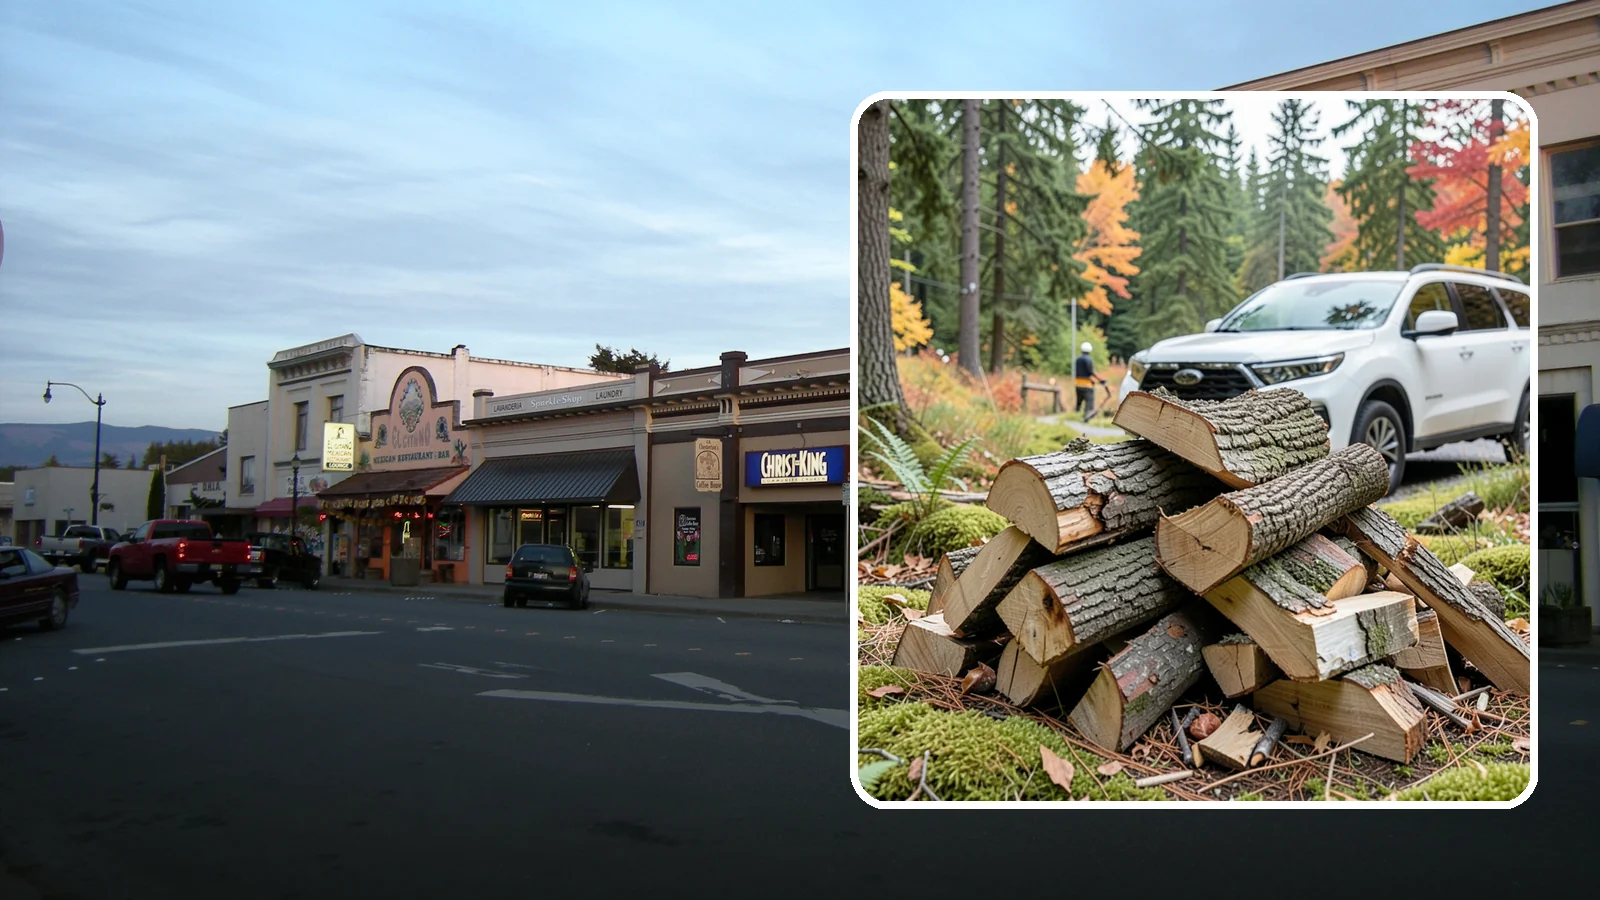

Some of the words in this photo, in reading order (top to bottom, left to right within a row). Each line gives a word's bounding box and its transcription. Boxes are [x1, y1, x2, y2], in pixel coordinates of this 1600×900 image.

[596, 389, 623, 400] LAUNDRY
[562, 395, 582, 405] Shop
[493, 402, 522, 412] LAVANDERIA
[374, 455, 396, 464] MEXICAN
[398, 451, 433, 462] RESTAURANT
[438, 450, 450, 459] BAR
[799, 450, 827, 476] KING
[697, 481, 709, 489] Coffee
[710, 481, 722, 489] House
